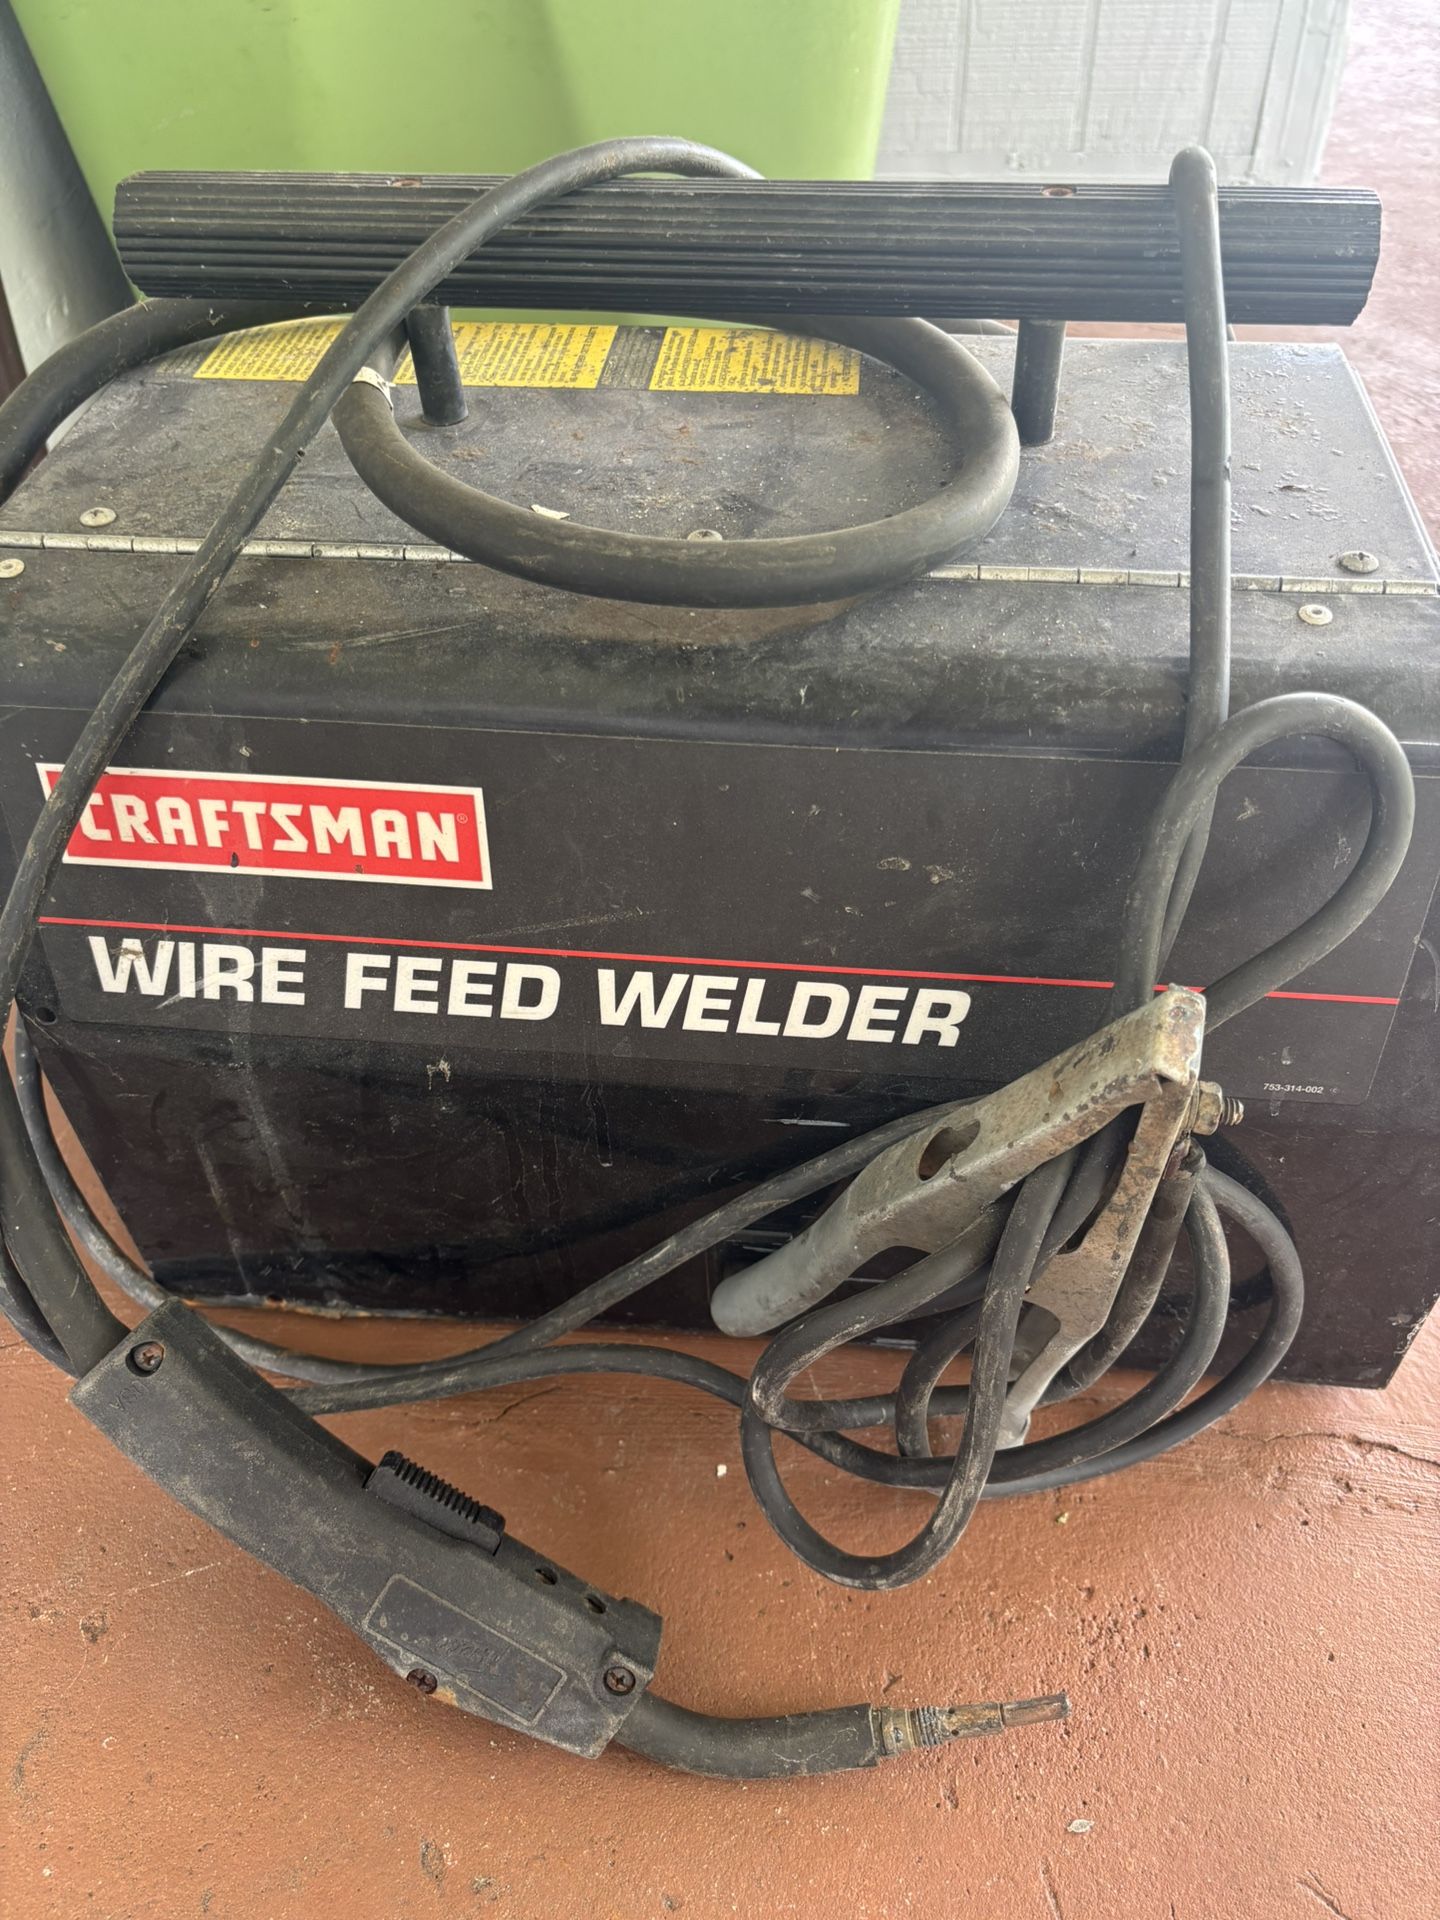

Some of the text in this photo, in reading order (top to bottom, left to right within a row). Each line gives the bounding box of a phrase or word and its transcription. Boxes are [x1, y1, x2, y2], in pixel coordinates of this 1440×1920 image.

[80, 791, 460, 863] CRAFTSMAN
[88, 935, 972, 1048] WIRE FEED WELDER
[1263, 1082, 1324, 1094] 753-314-002
